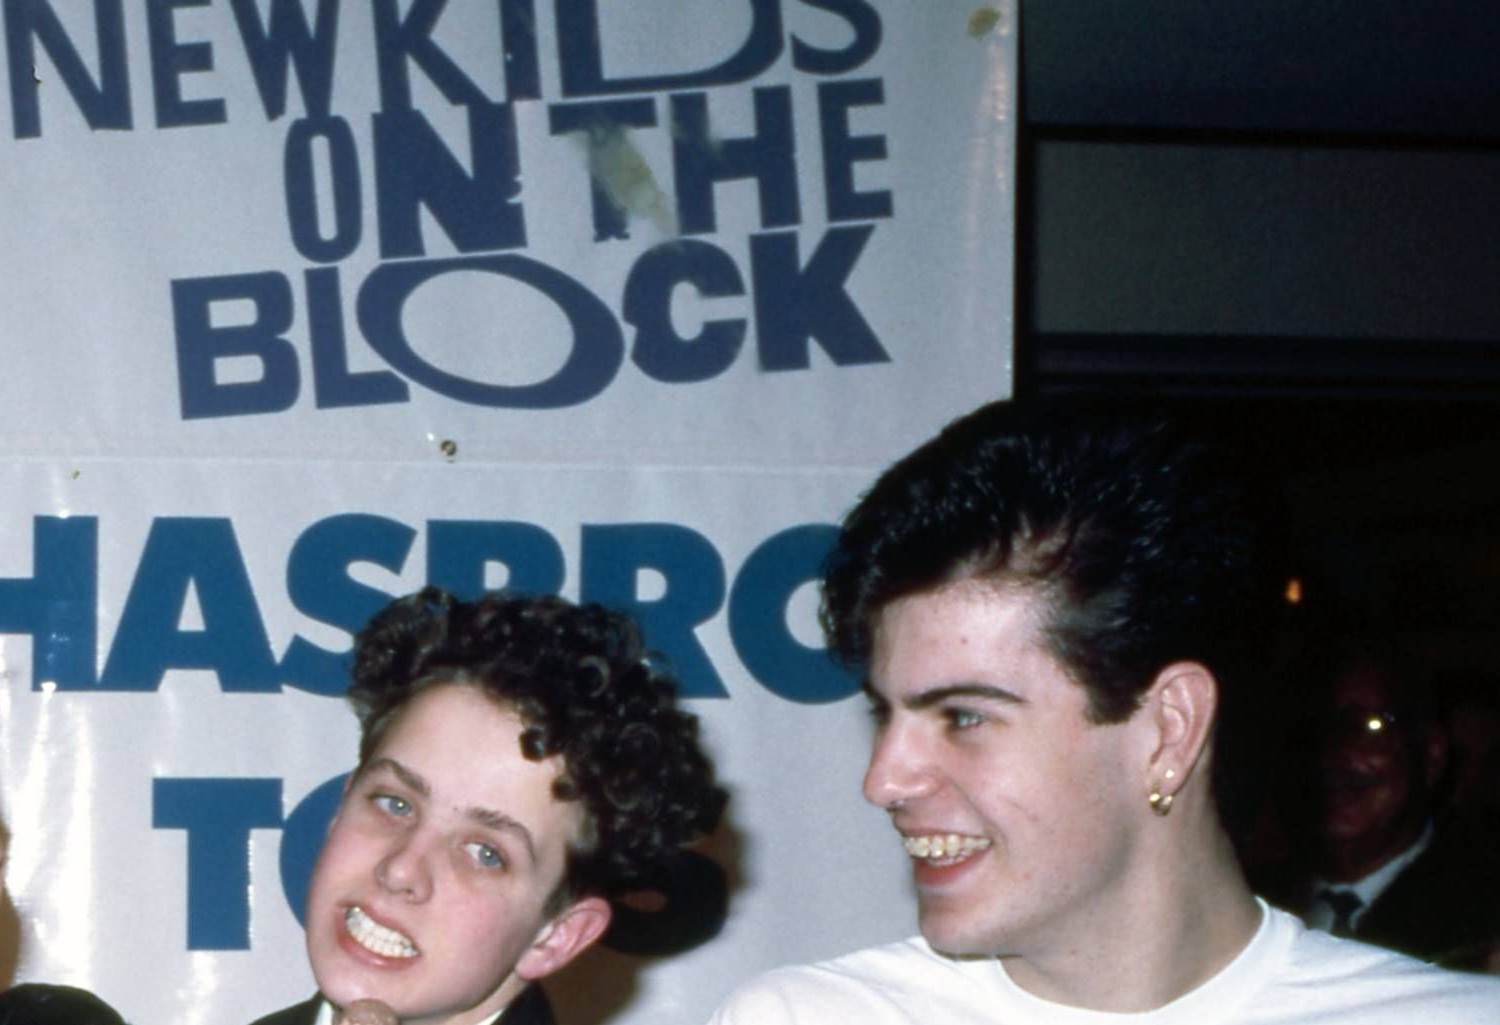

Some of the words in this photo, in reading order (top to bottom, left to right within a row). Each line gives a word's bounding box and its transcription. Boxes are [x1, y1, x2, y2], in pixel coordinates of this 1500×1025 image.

[284, 102, 528, 263] ON
[549, 77, 895, 243] THE
[170, 224, 893, 420] BLOCK
